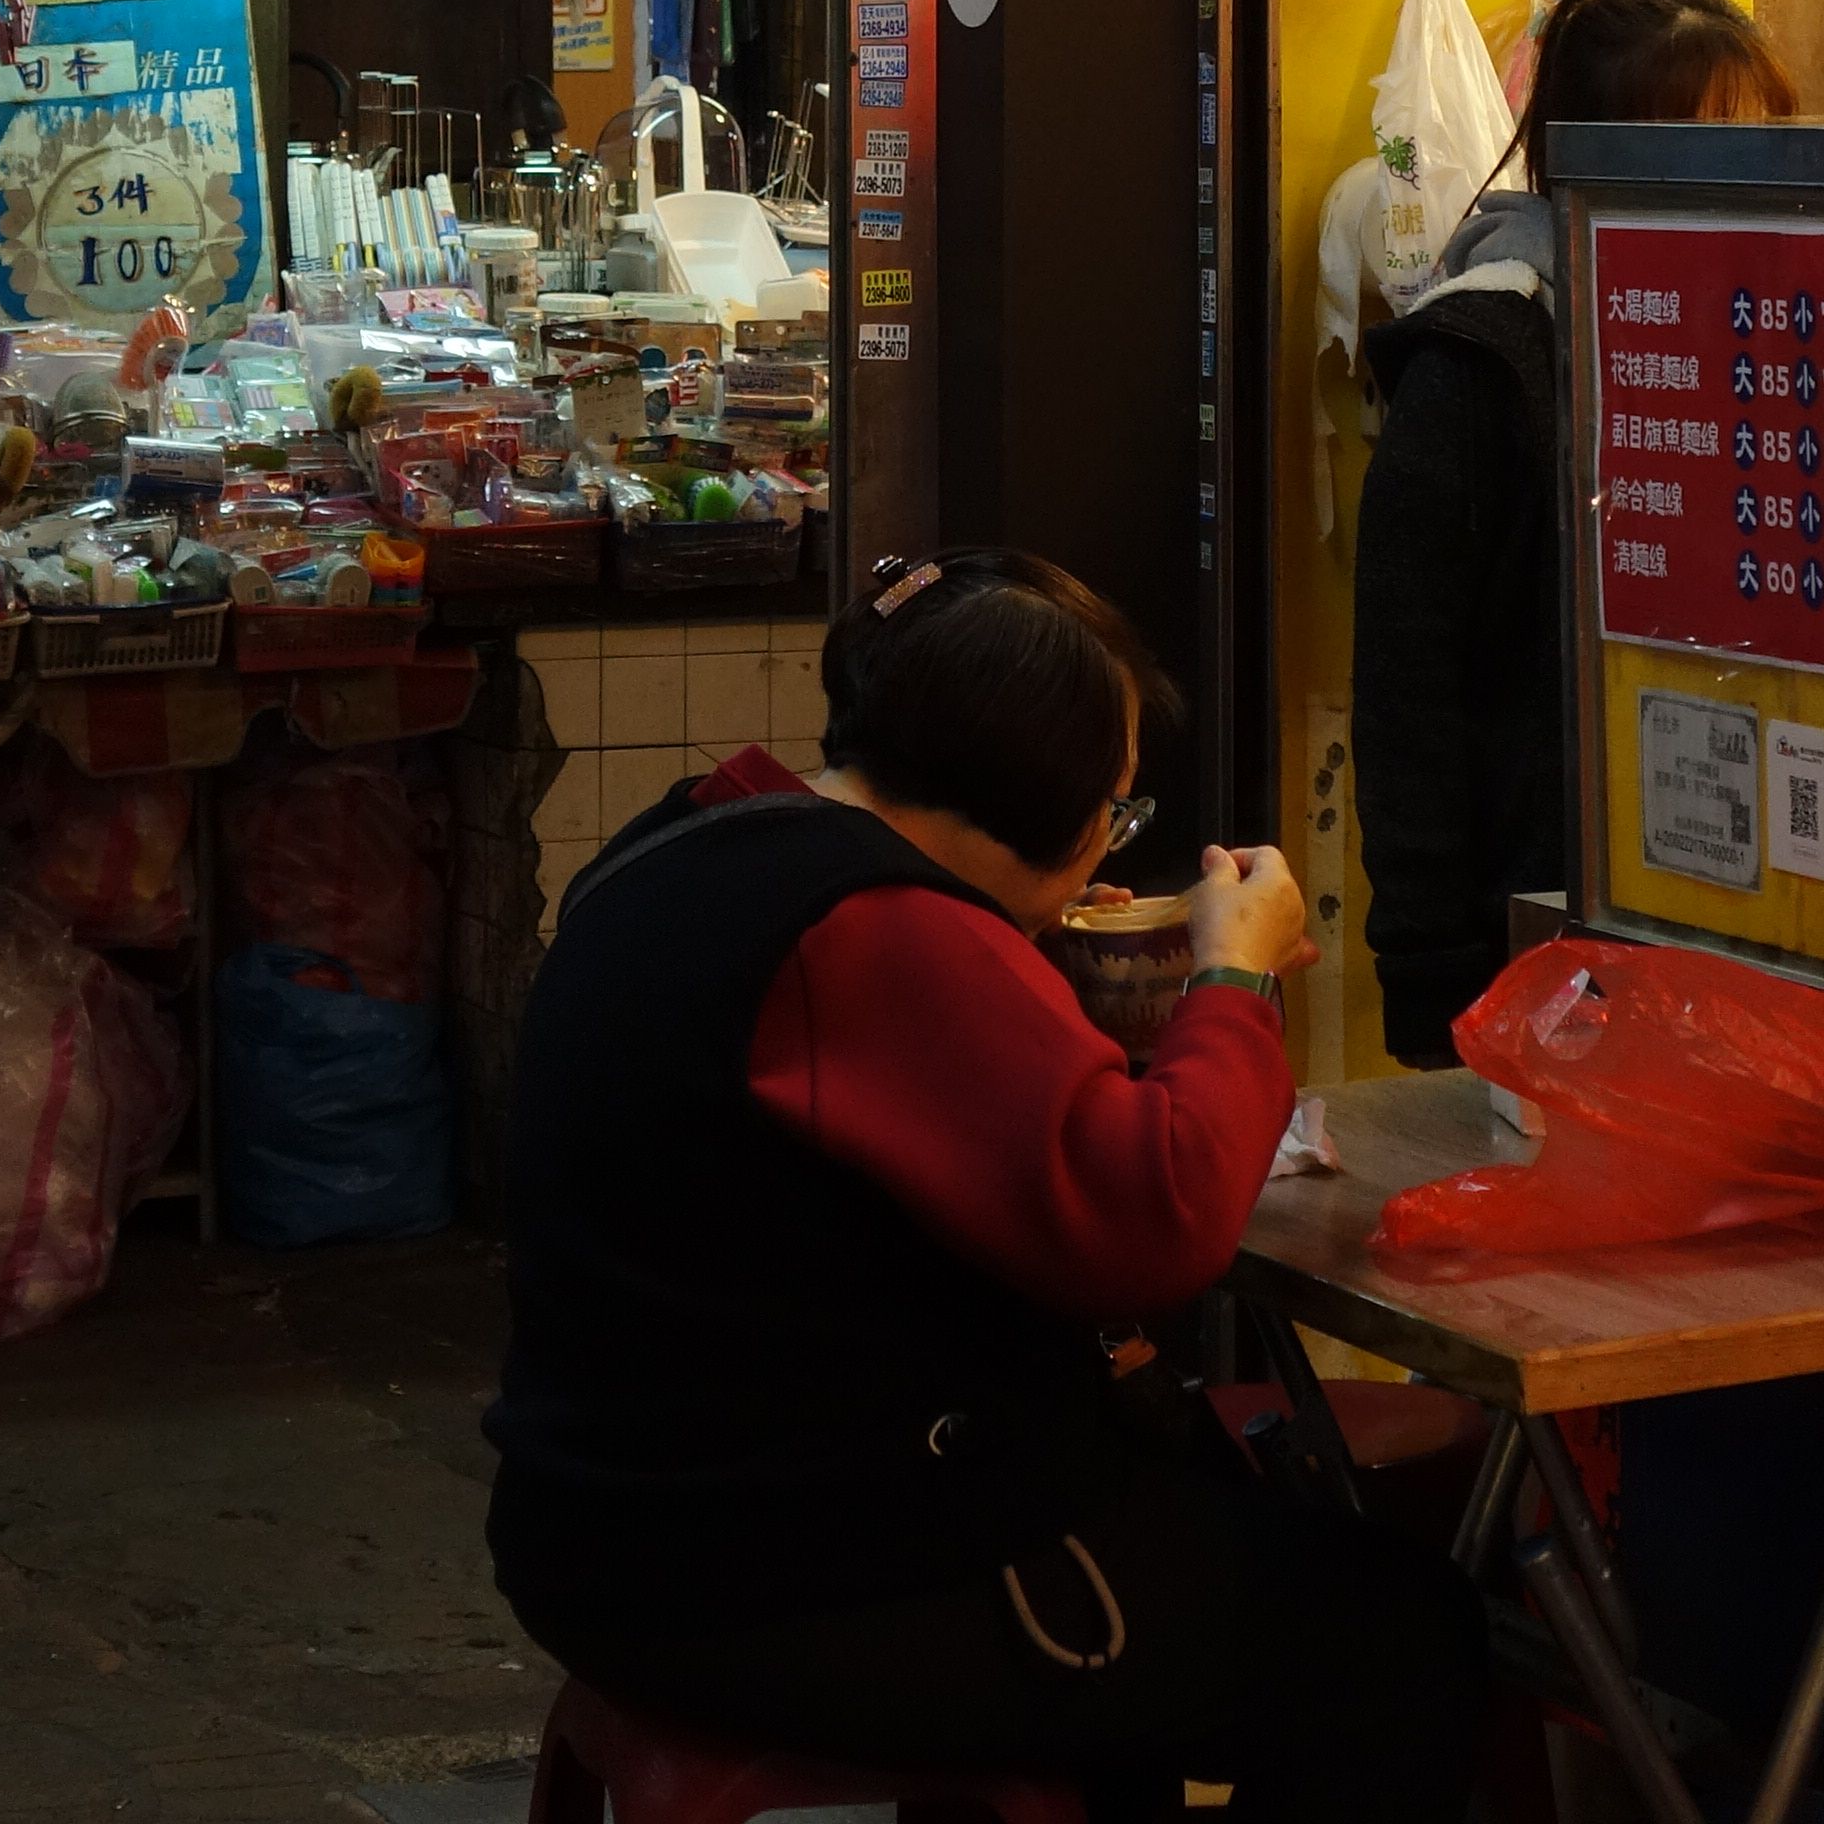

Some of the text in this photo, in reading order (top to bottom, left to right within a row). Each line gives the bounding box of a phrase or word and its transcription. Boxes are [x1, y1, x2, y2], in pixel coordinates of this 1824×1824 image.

[137, 47, 226, 90] 精品
[856, 176, 903, 195] 2396-5073
[76, 235, 174, 287] 100
[1607, 287, 1682, 326] 大腸麵線
[1733, 293, 1755, 332] 大
[1760, 298, 1788, 331] 85
[1794, 296, 1814, 334] 小
[860, 340, 908, 359] 2396-5073
[1610, 351, 1701, 391] 花枝羹麵線
[1735, 357, 1755, 396] 大
[1761, 364, 1790, 398] 85
[1796, 363, 1816, 401] 小
[1736, 424, 1756, 462] 大
[1762, 430, 1791, 463] 85
[1798, 430, 1818, 468] 小
[1611, 477, 1684, 518] 綜合麵線
[1737, 488, 1757, 528] 大
[1764, 496, 1794, 530] 85
[1800, 497, 1821, 536] 小
[1612, 539, 1668, 579] 清麵線
[1738, 555, 1759, 593] 大
[1767, 562, 1796, 595] 60
[1802, 563, 1823, 602] 小
